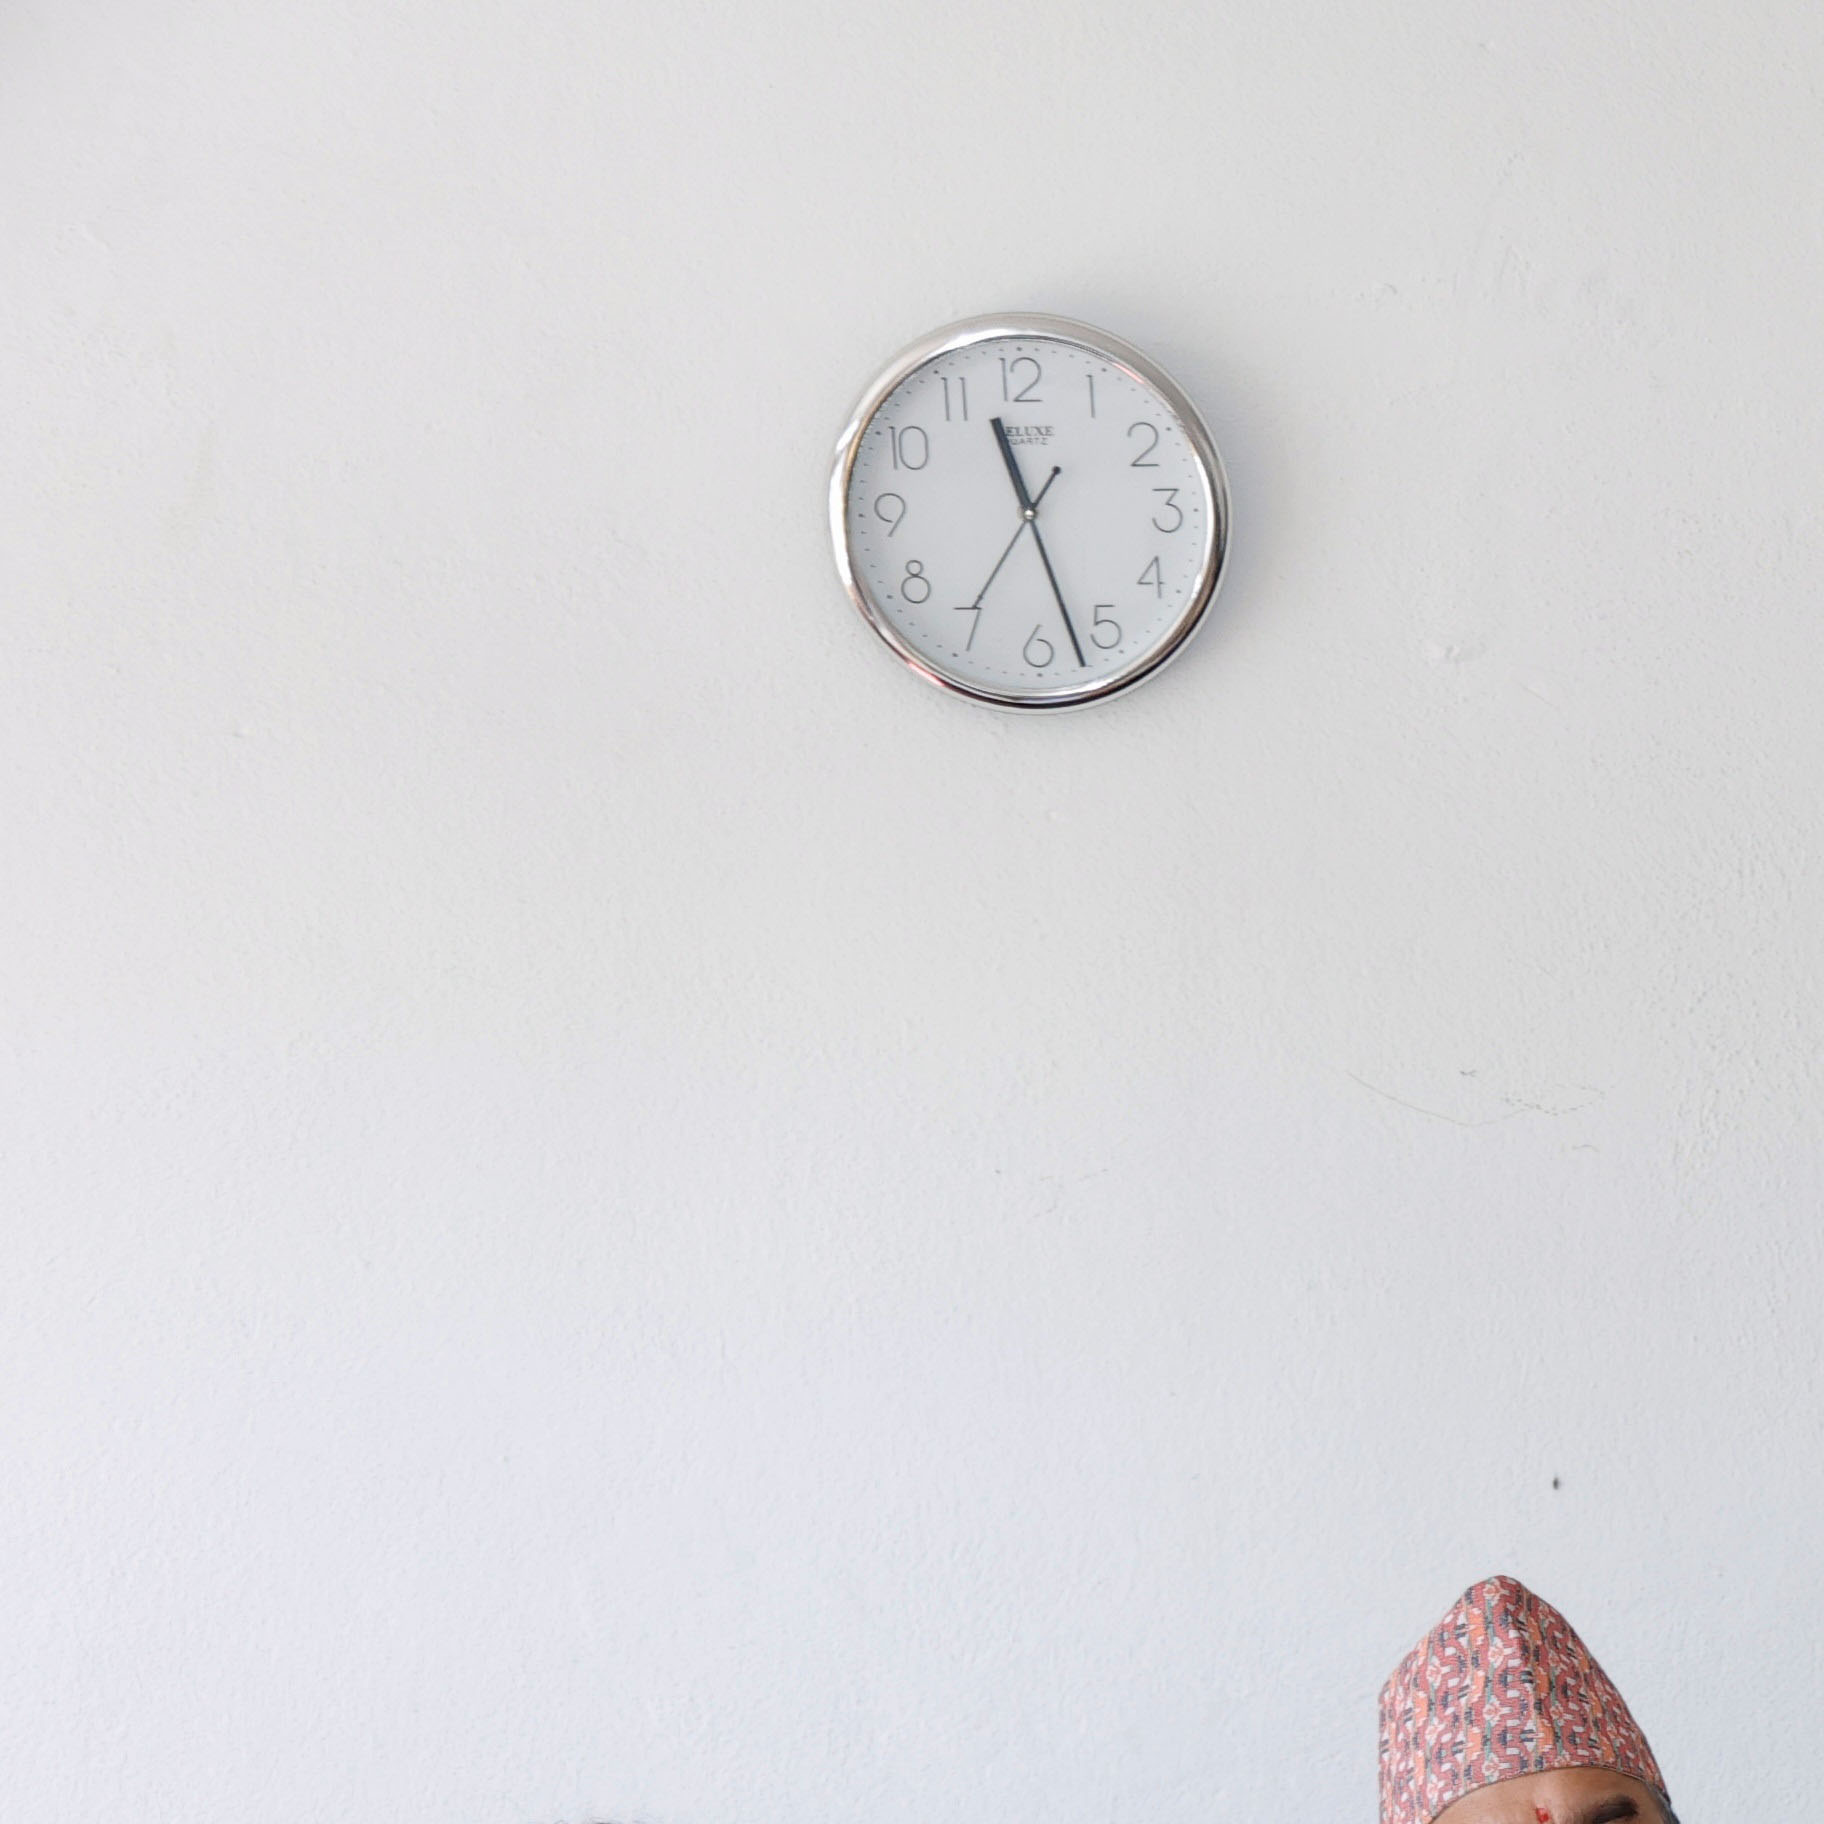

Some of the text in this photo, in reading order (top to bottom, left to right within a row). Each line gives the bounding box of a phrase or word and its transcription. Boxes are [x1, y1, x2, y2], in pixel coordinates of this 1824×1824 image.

[941, 377, 968, 421] 11
[999, 357, 1043, 402] 12
[1085, 374, 1096, 419] 1
[888, 425, 929, 470] 10
[1003, 425, 1056, 437] ELUXE
[1127, 422, 1160, 467] 2
[874, 493, 906, 537] 9
[1152, 489, 1184, 533] 3
[901, 560, 931, 604] 8
[1137, 556, 1165, 599] 4
[954, 607, 982, 652] 7
[1023, 624, 1054, 668] 6
[1090, 605, 1122, 650] 5
